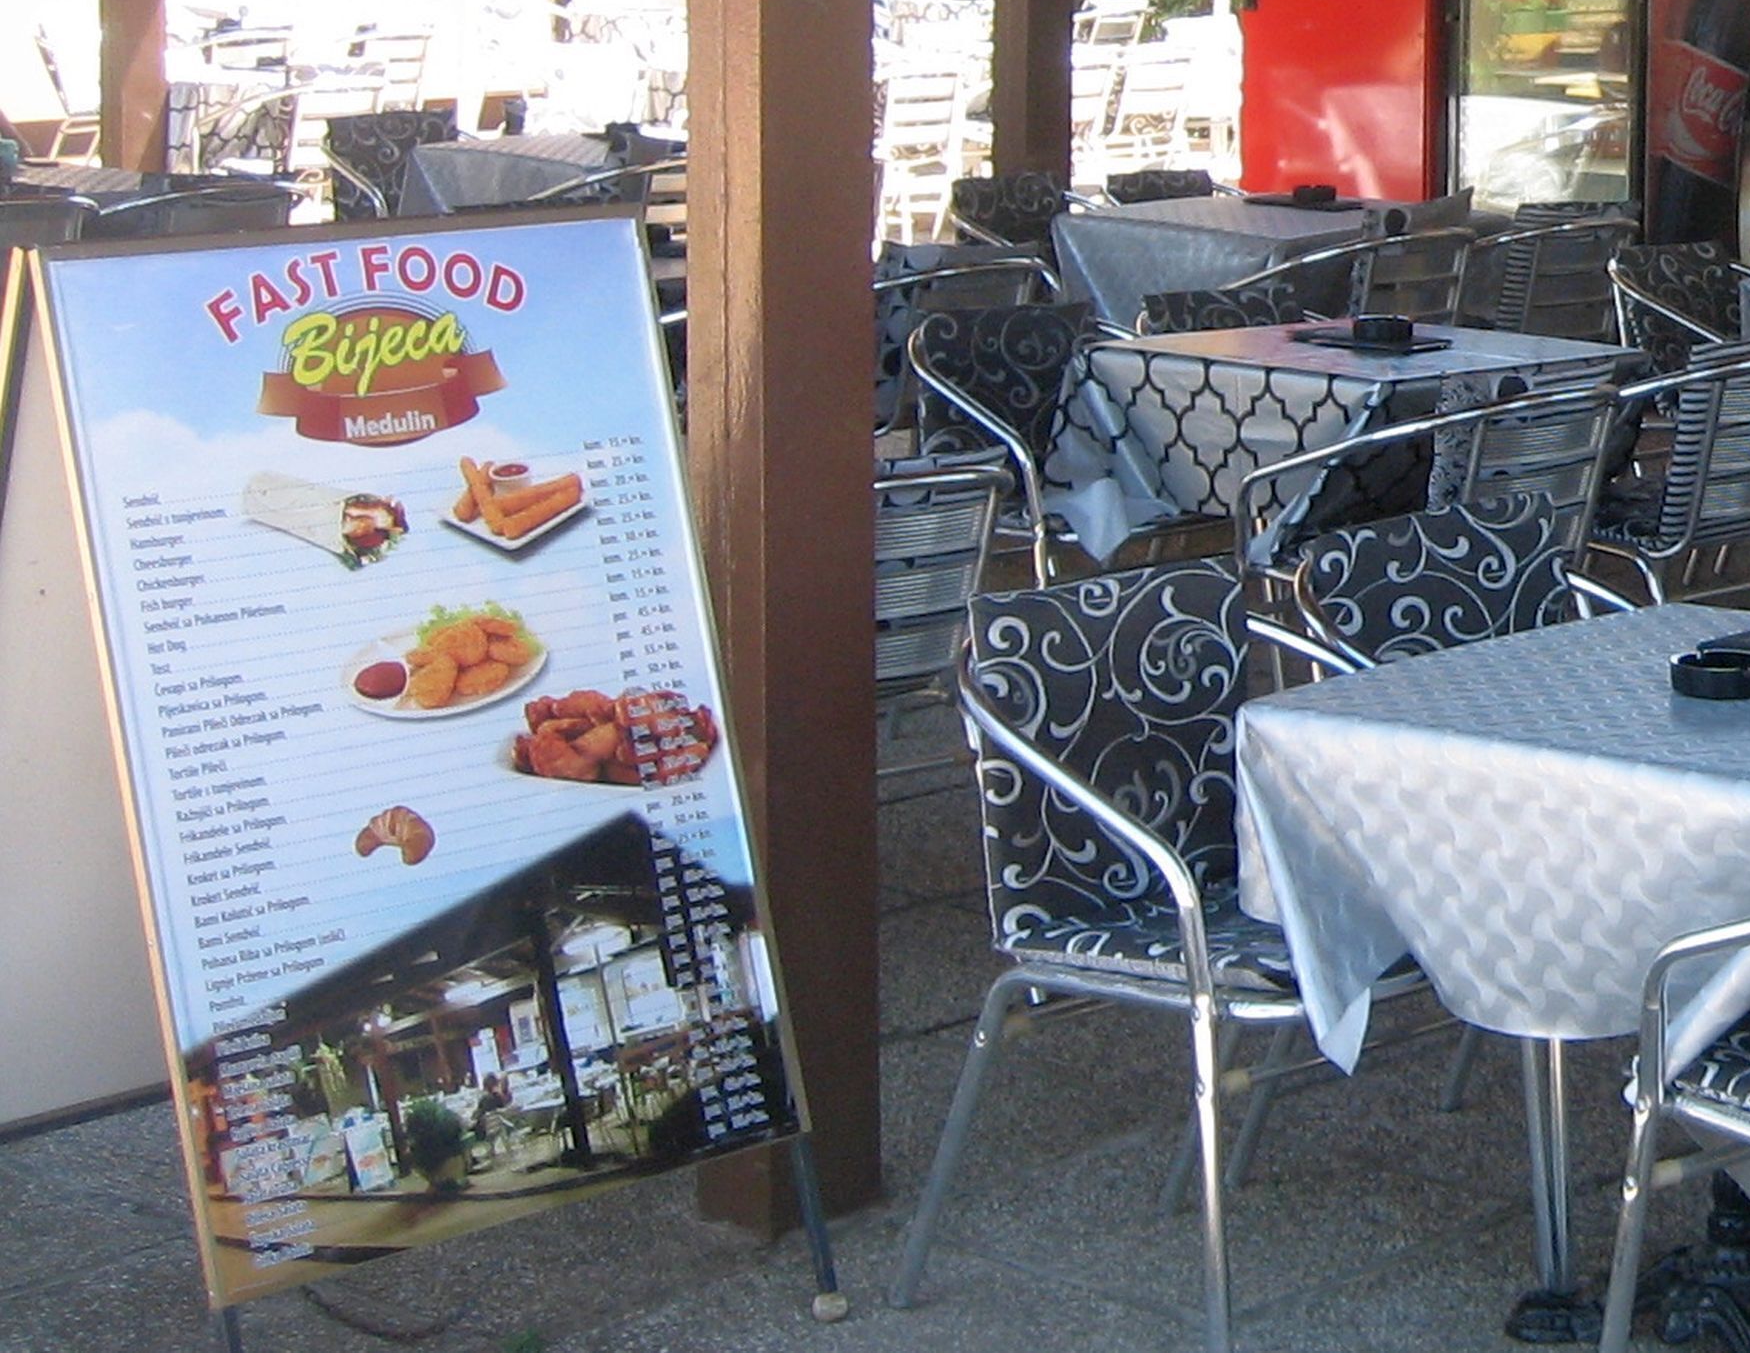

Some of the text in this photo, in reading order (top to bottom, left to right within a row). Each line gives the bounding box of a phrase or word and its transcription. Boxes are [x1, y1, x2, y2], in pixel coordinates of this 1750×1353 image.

[205, 244, 526, 344] FAST FOOD
[282, 310, 466, 398] Bijeca
[343, 410, 436, 440] Medulin
[129, 535, 184, 550] Hamburger
[140, 597, 193, 612] Fish burger
[147, 639, 188, 655] Hot Dog
[200, 674, 244, 689] Prilogom
[223, 691, 268, 707] Prilogom
[281, 702, 324, 718] Prilogom
[243, 730, 287, 746] Prilogom
